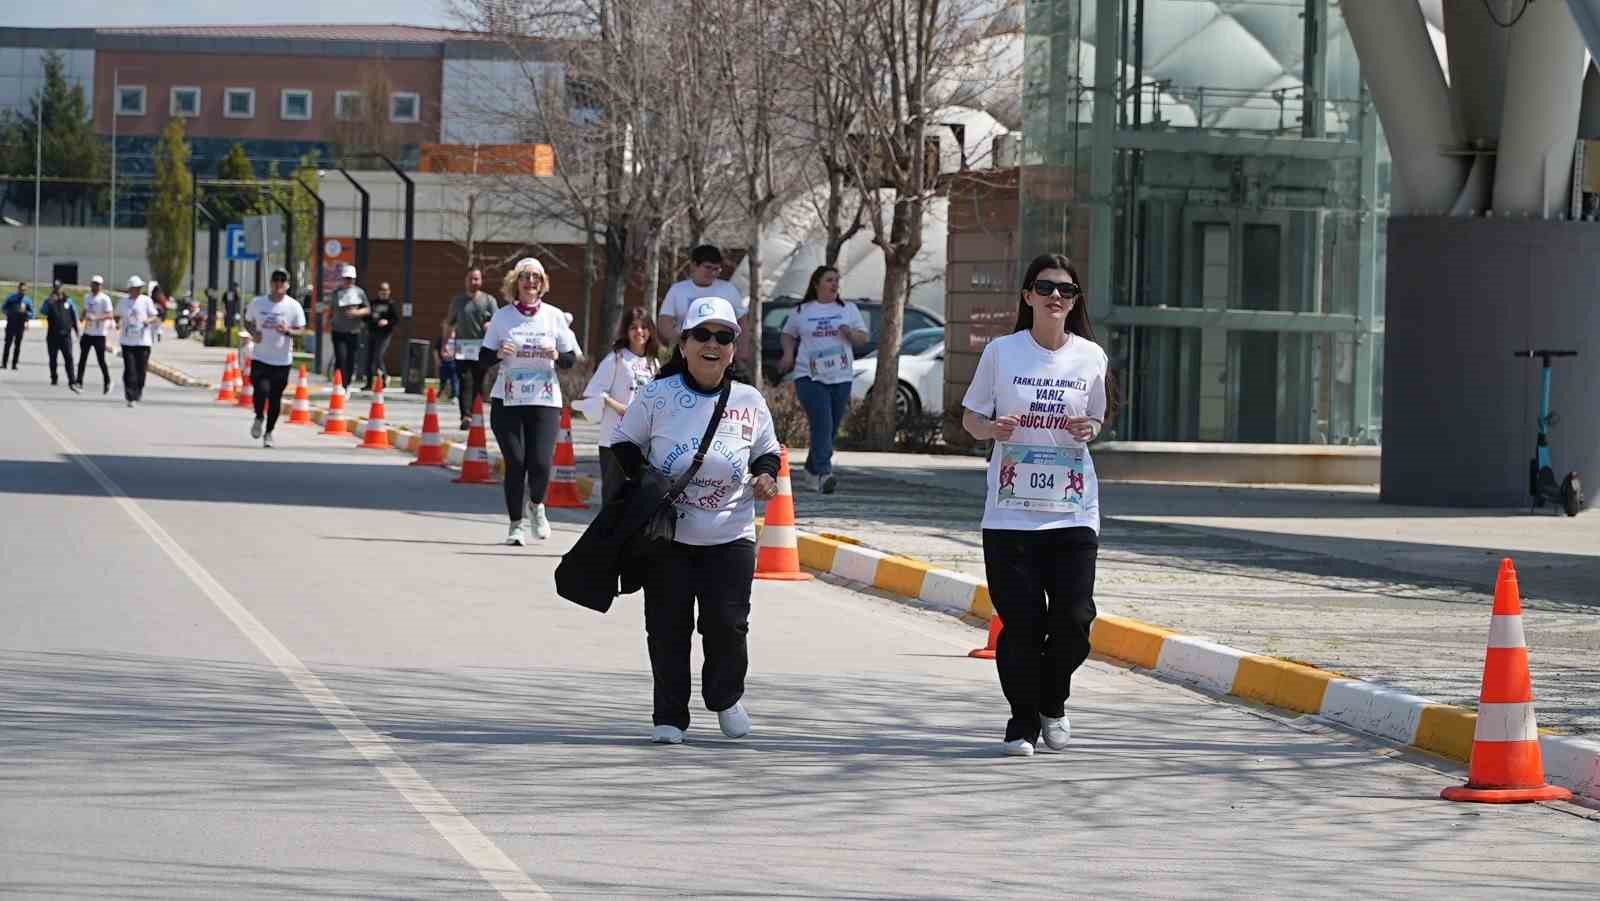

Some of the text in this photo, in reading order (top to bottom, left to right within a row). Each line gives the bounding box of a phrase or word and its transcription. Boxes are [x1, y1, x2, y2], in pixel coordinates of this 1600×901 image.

[1036, 389, 1065, 401] VARIZ
[1029, 401, 1066, 414] BİRLİKTE
[1030, 472, 1055, 490] 034
